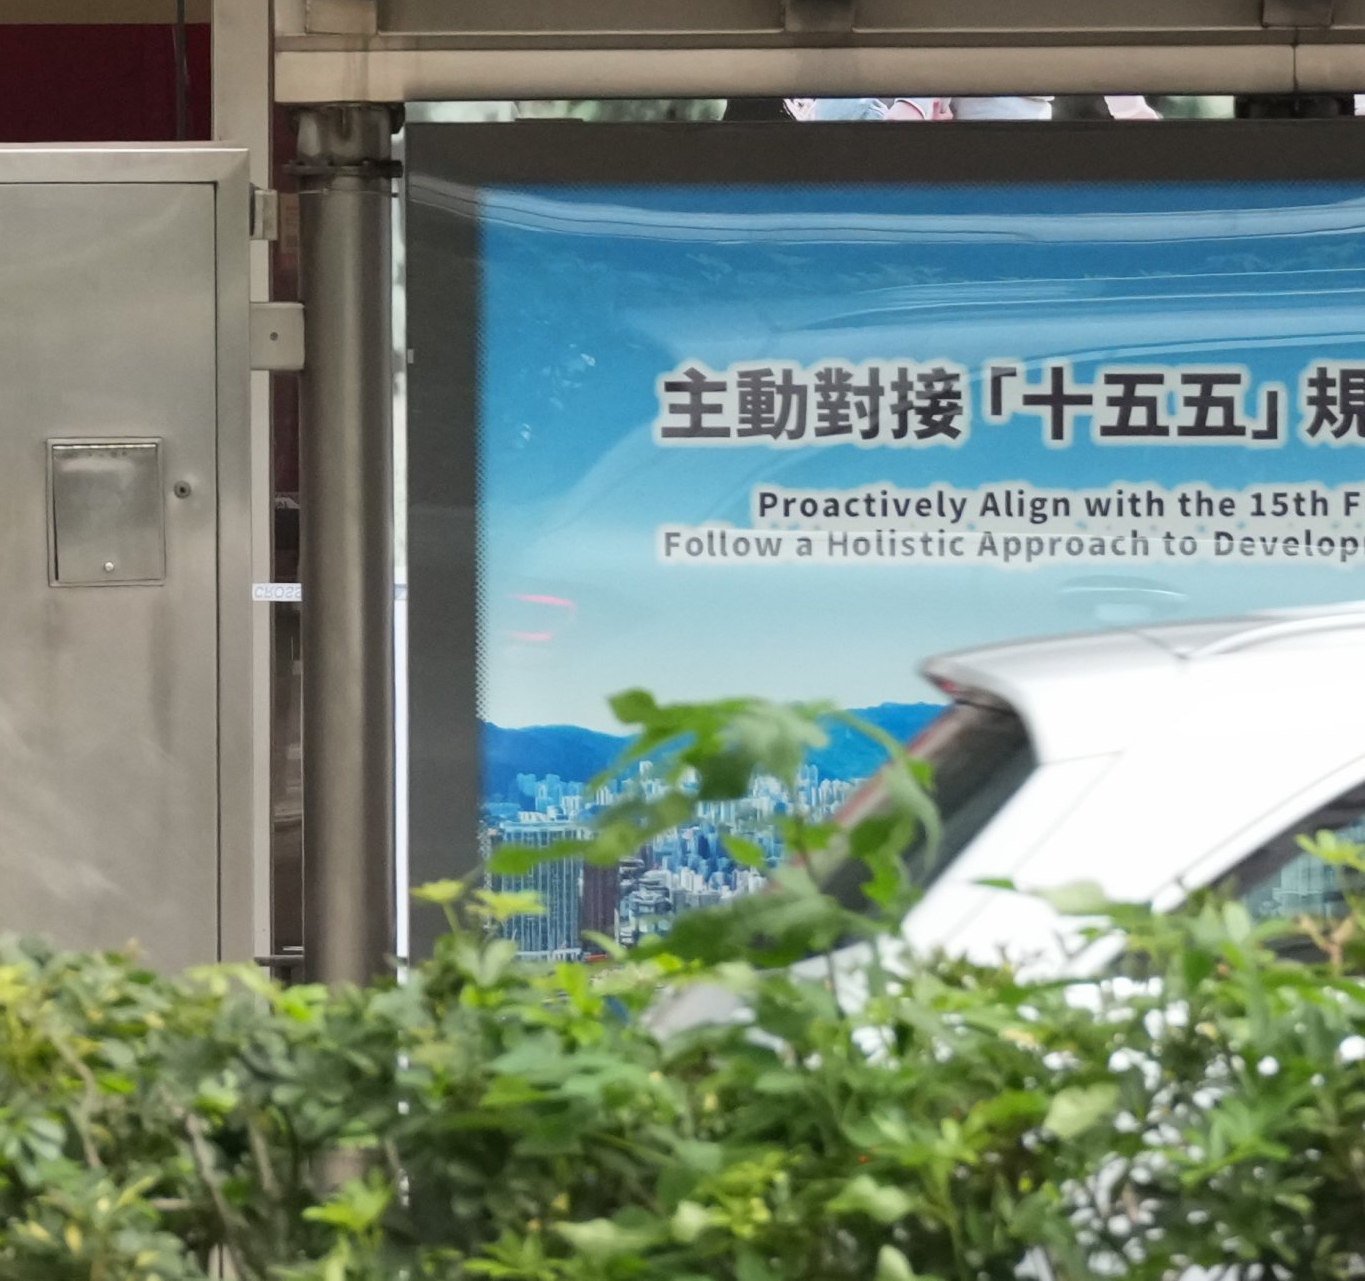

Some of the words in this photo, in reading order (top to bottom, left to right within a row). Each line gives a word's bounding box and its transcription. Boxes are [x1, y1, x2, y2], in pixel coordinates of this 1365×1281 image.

[758, 489, 968, 524] Proactively
[979, 489, 1070, 524] Align
[1084, 489, 1165, 517] with
[1177, 490, 1236, 517] the
[1249, 490, 1329, 517] 15th
[663, 529, 783, 557] Follow
[795, 537, 813, 557] a
[827, 528, 966, 557] Holistic
[976, 529, 1150, 563] Approach
[1163, 534, 1198, 557] to
[1214, 528, 1365, 563] Develop
